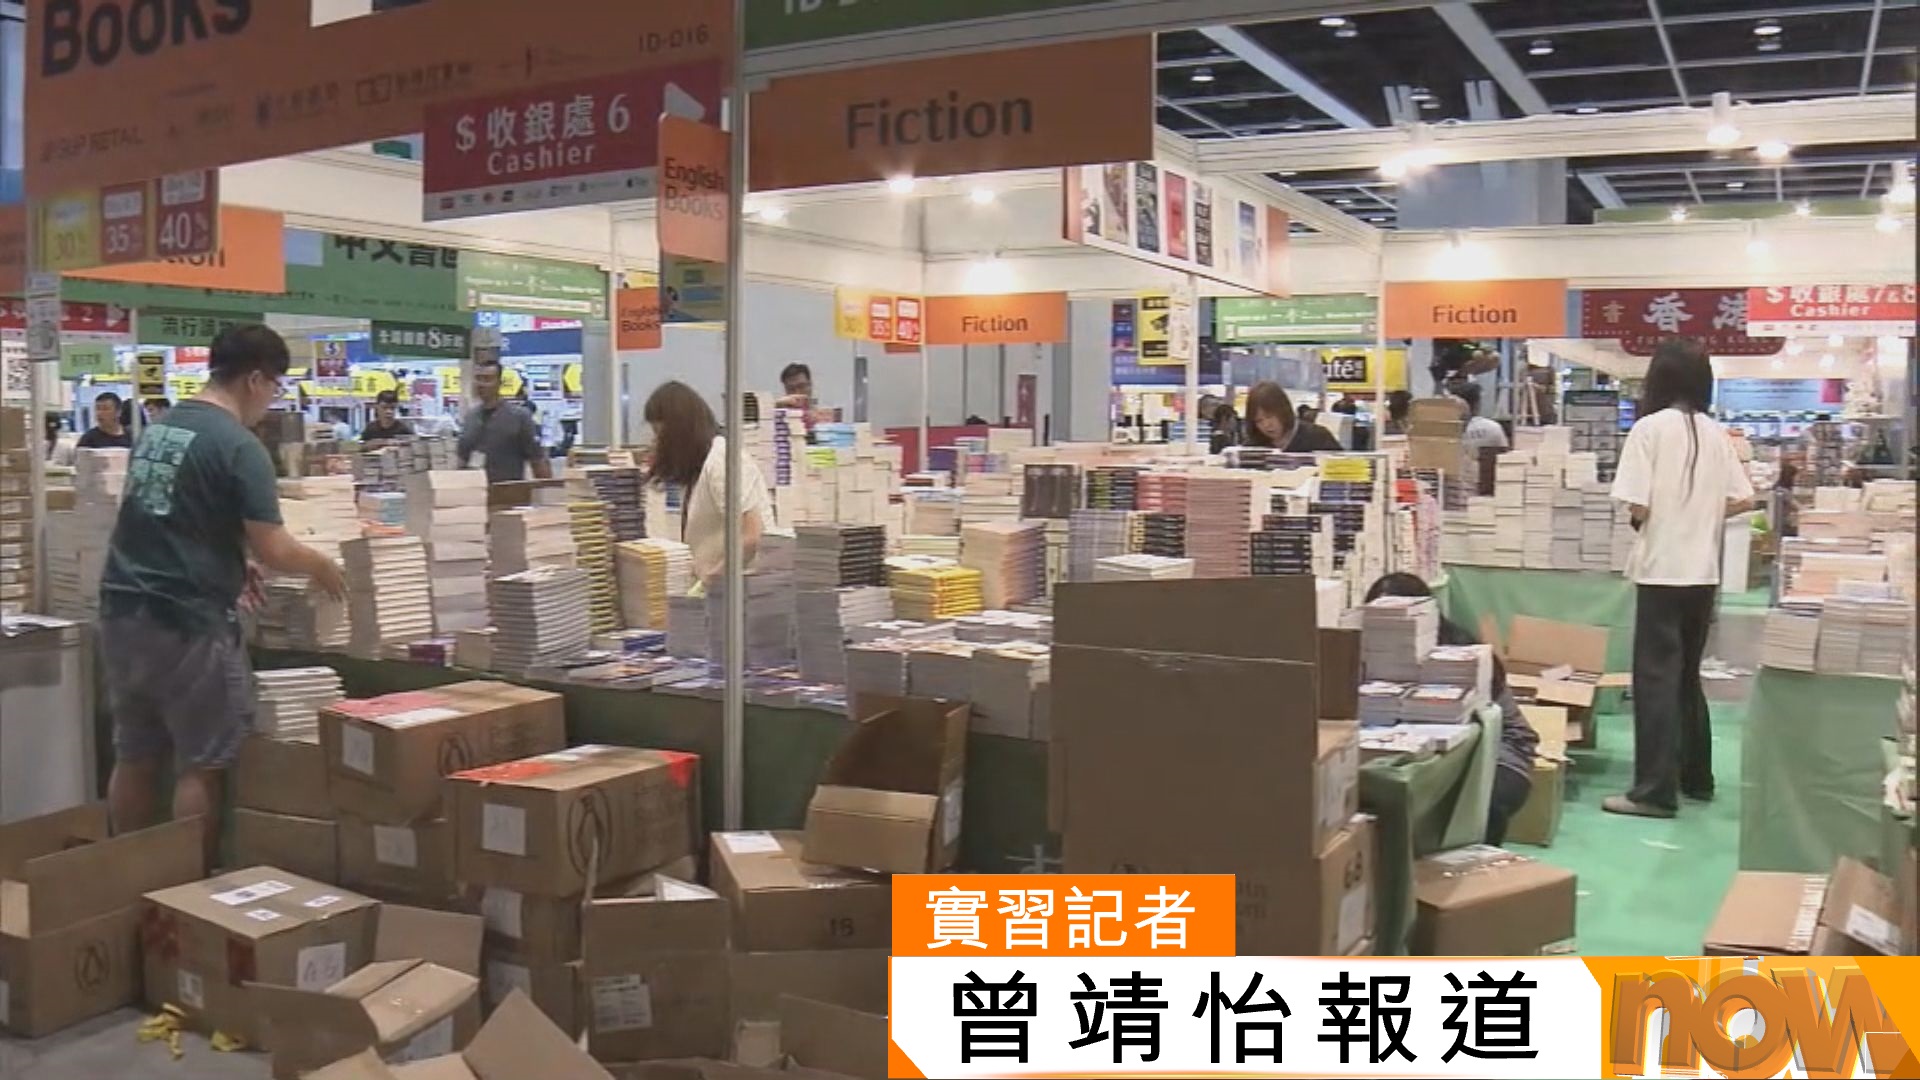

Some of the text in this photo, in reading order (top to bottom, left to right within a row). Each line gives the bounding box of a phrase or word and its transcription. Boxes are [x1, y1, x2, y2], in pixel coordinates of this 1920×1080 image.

[486, 93, 596, 150] 收銀處
[607, 93, 631, 134] 6
[846, 90, 1033, 150] Fiction
[486, 141, 596, 177] Cashier
[664, 157, 725, 192] English
[664, 184, 722, 220] Books
[961, 315, 1029, 333] Fiction
[1432, 304, 1518, 325] Fiction
[1789, 303, 1871, 318] Cashier
